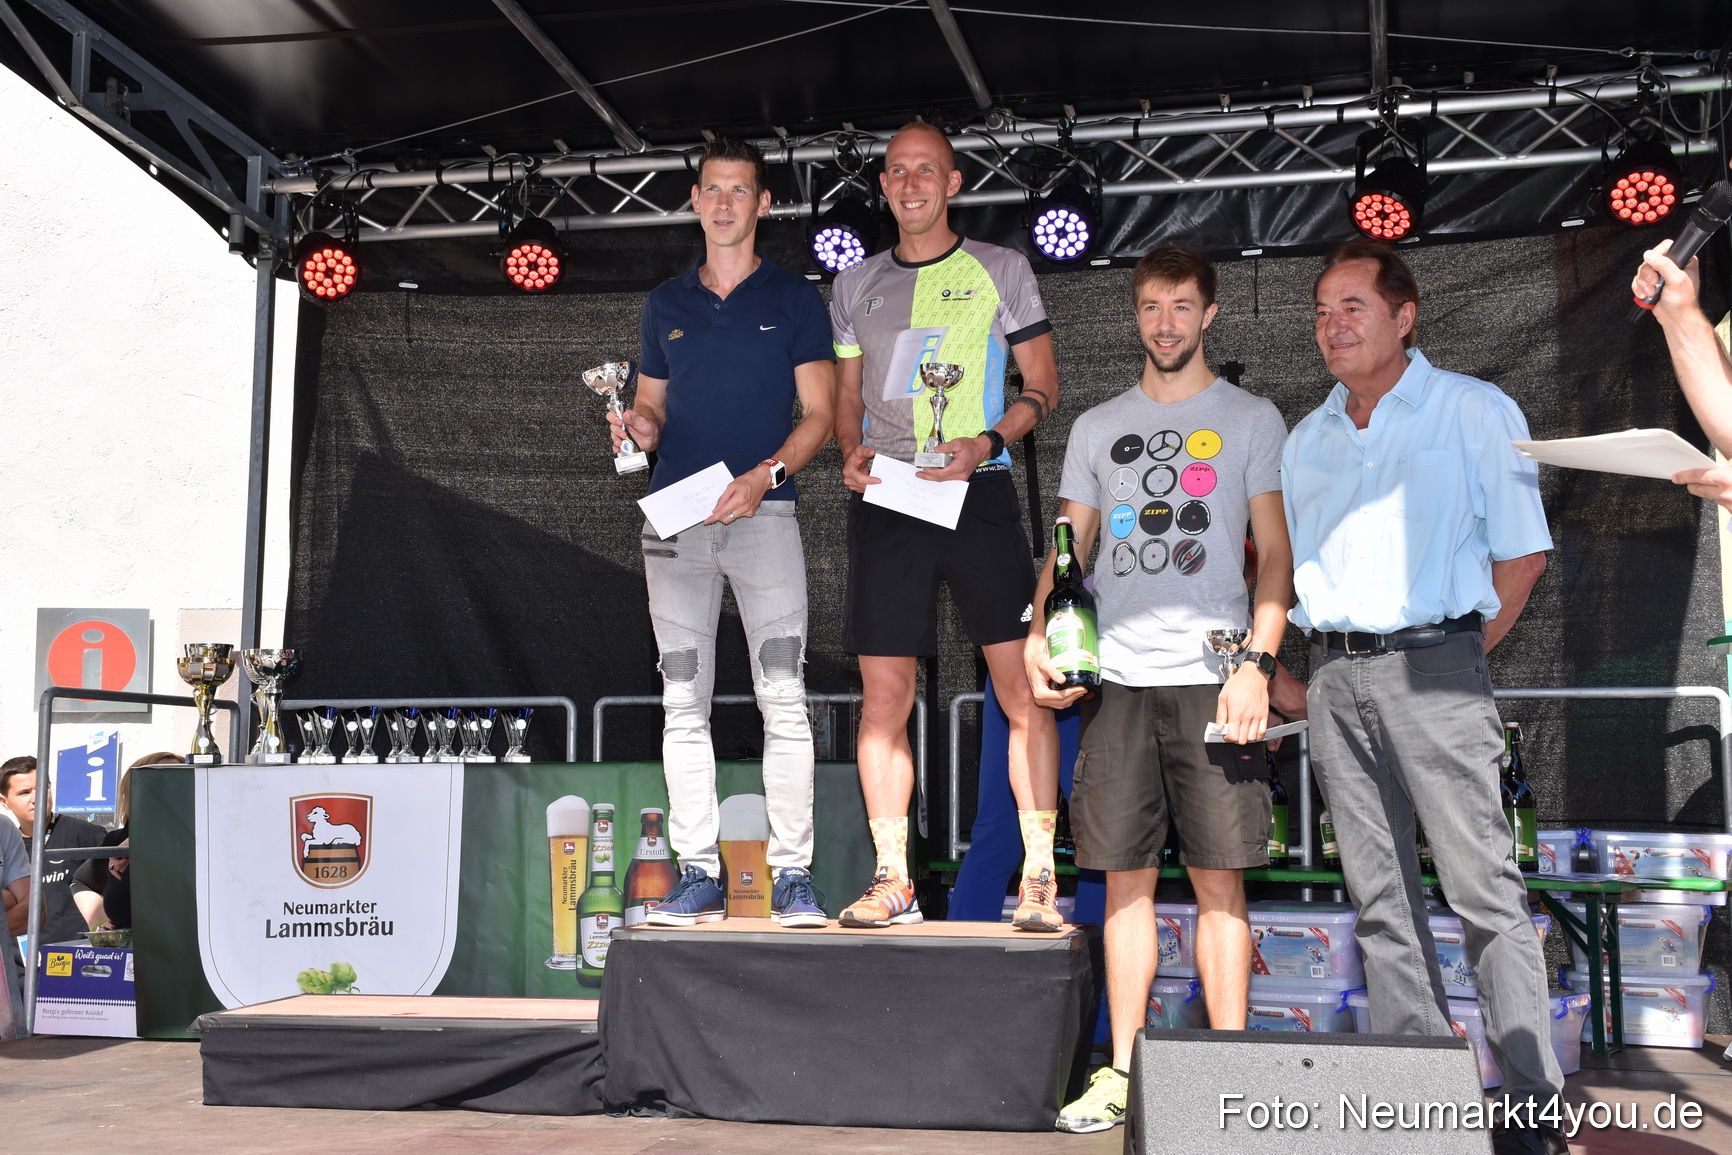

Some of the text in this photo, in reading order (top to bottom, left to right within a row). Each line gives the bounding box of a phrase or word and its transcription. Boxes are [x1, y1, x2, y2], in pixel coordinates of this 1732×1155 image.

[314, 865, 348, 879] 1628
[568, 859, 577, 911] Lammsbräu
[283, 899, 378, 916] Neumarkter
[265, 915, 394, 939] Lammsbräu
